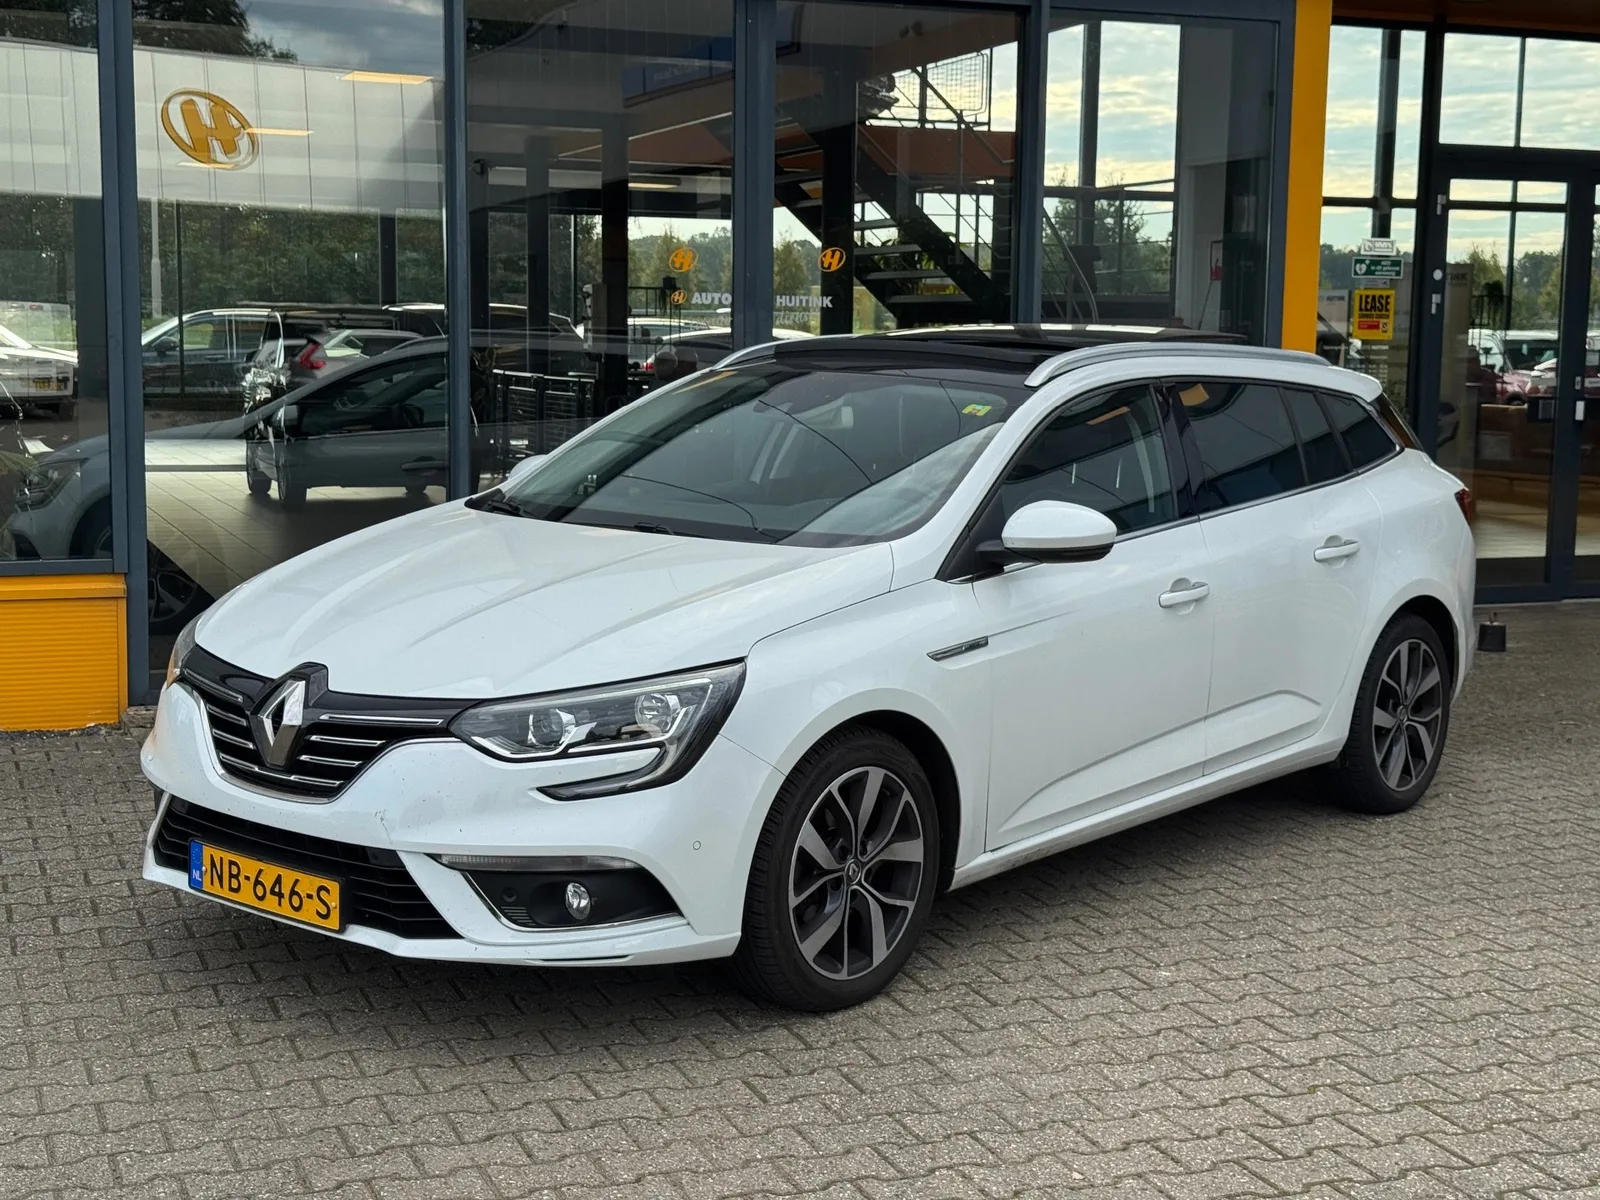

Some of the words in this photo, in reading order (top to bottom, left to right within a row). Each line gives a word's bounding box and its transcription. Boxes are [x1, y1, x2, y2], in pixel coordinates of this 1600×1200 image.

[691, 292, 732, 305] AUTO
[776, 295, 833, 308] HUITINK
[1359, 294, 1391, 312] LEASE
[192, 869, 202, 882] NL
[209, 853, 331, 920] NB-646-S
